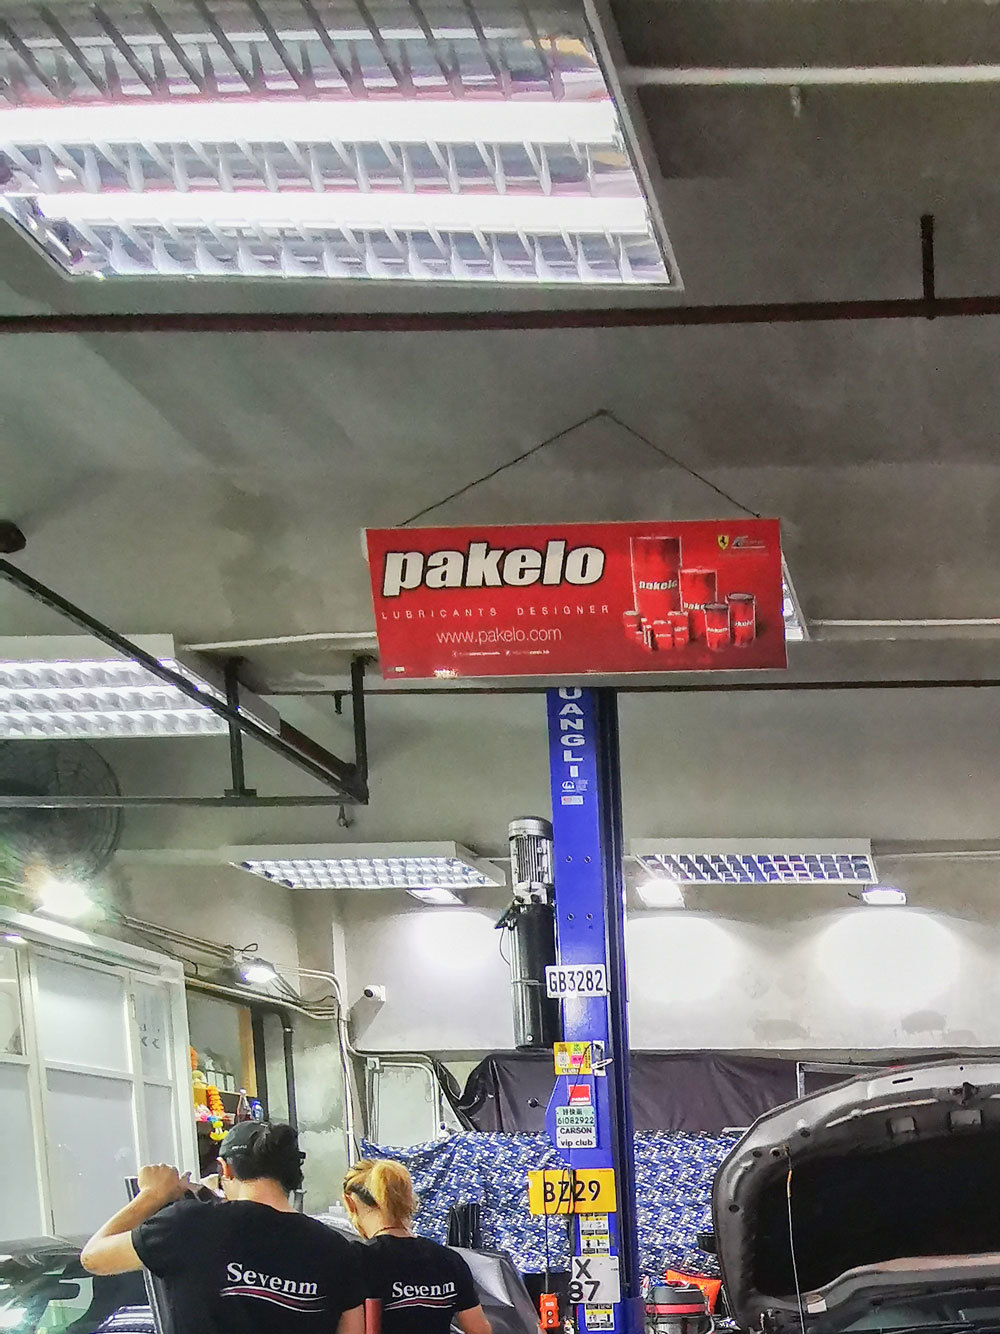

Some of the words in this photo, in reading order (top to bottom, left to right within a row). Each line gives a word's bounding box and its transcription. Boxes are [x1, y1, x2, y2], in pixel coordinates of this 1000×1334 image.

[382, 540, 606, 598] pakelo
[382, 607, 498, 620] LUBRICANTS
[517, 604, 610, 616] DESIGNER
[436, 627, 562, 645] www.pakelo.com
[549, 968, 604, 993] GB3282
[560, 1139, 573, 1147] vip
[575, 1138, 593, 1146] club
[226, 1261, 318, 1296] Sevenm
[574, 1258, 592, 1280] X
[391, 1280, 456, 1298] Sevenm
[569, 1280, 601, 1302] 87
